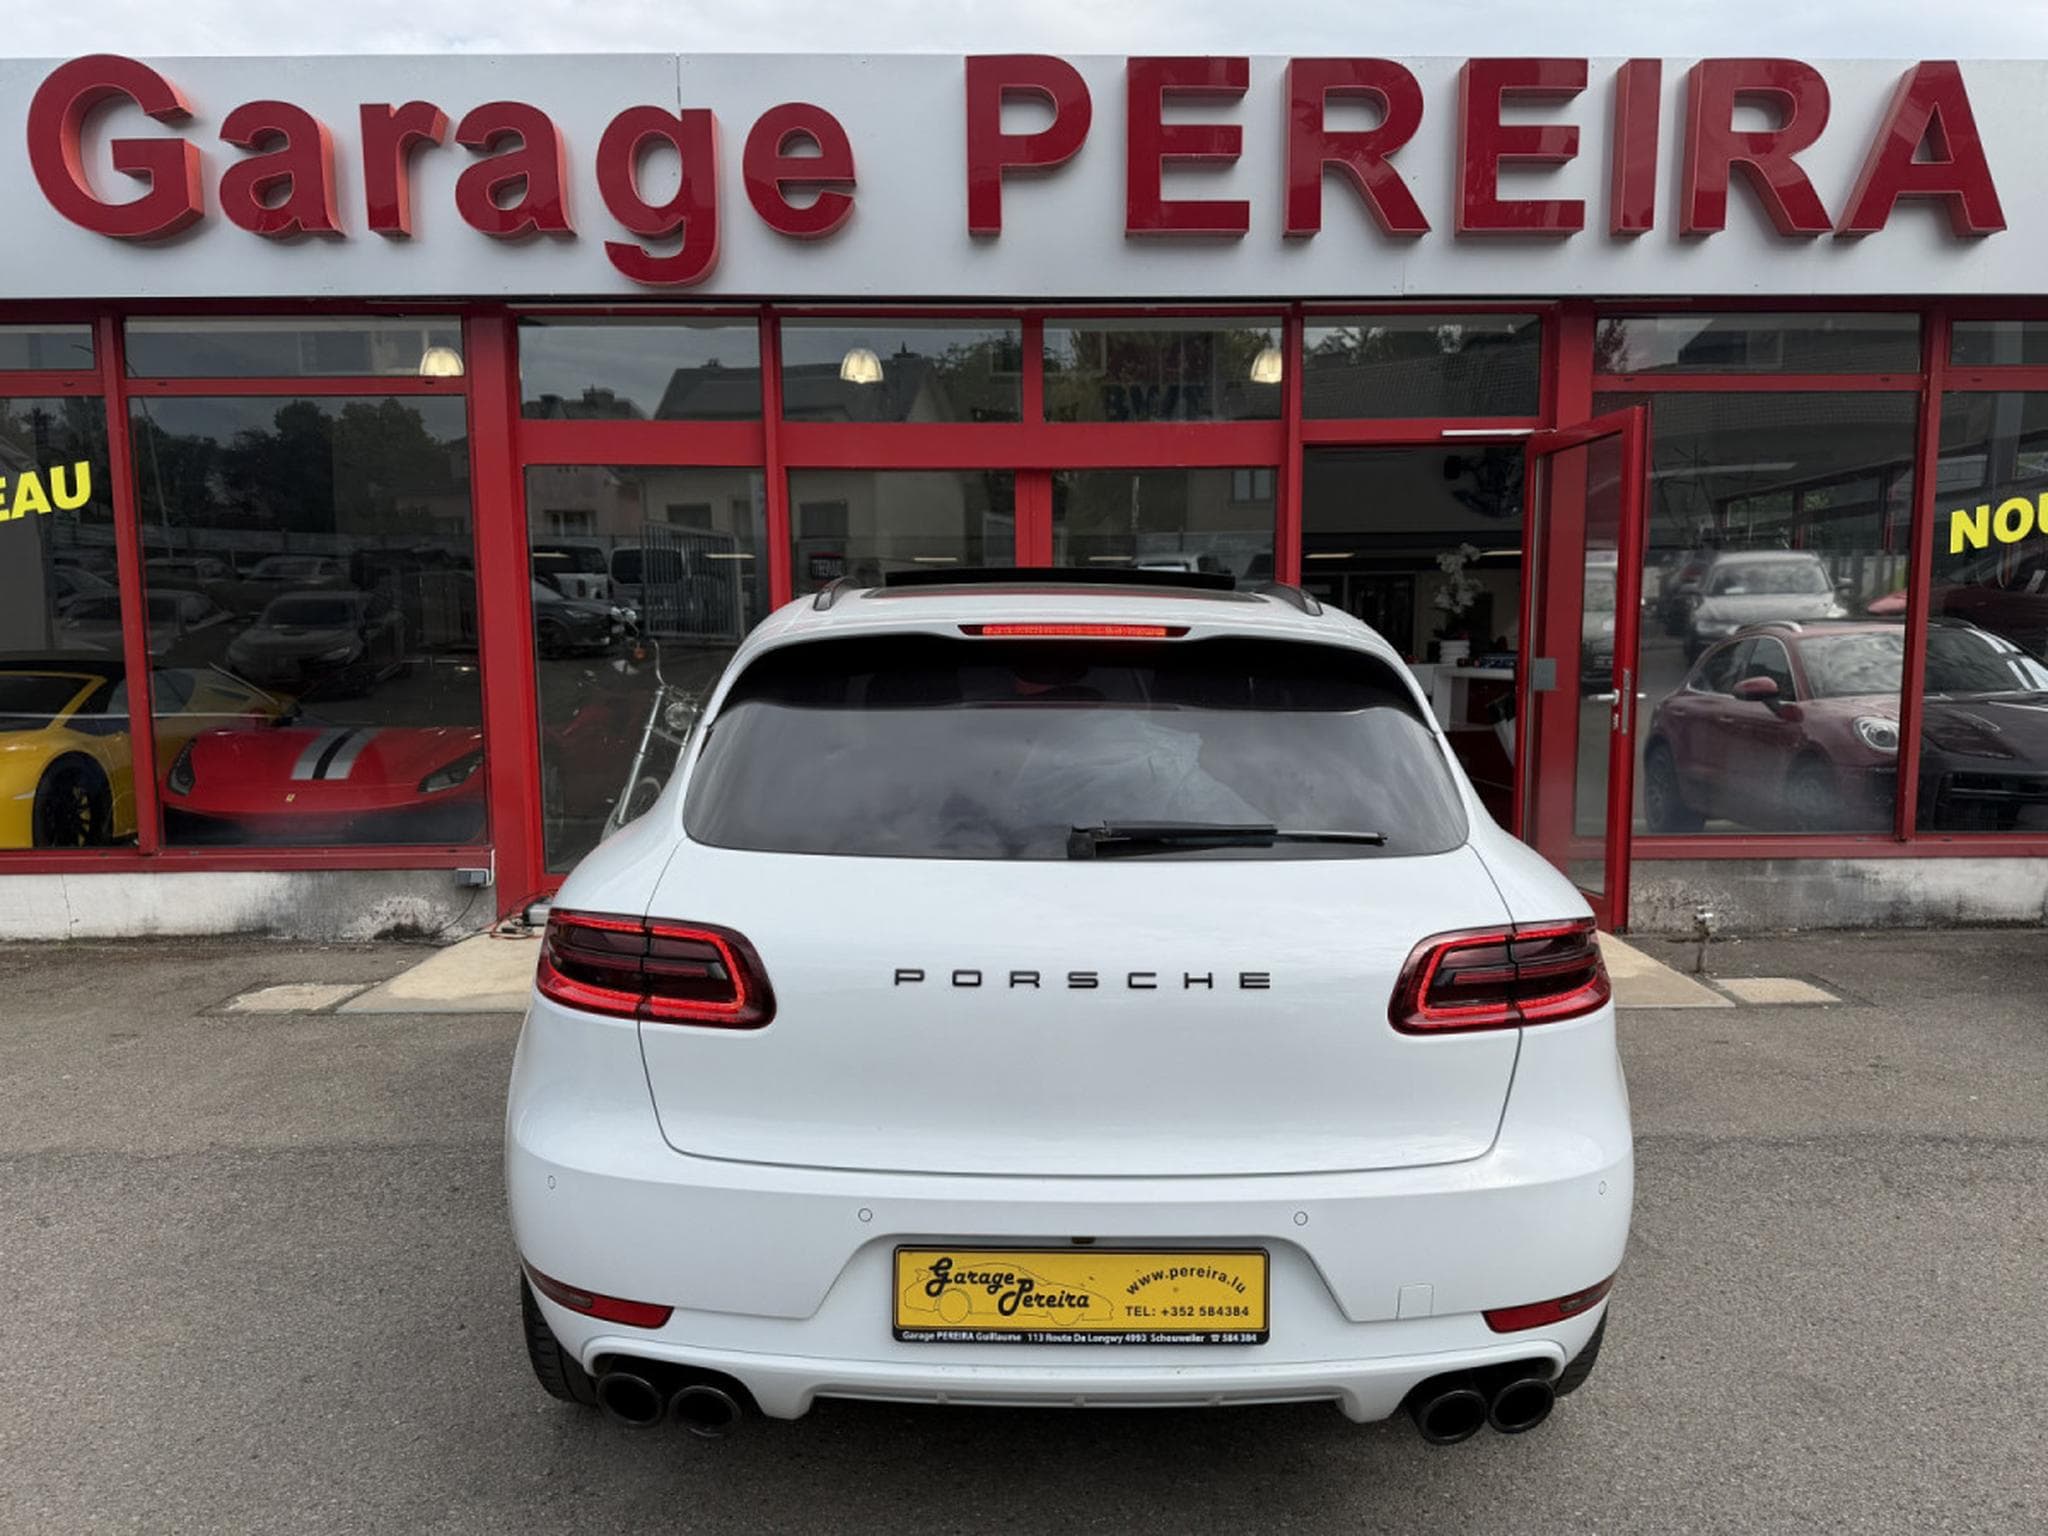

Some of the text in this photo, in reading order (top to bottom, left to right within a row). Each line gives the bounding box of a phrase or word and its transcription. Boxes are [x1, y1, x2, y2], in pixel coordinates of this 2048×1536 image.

[26, 52, 2007, 286] Garage PEREIRA
[1950, 492, 2048, 554] NO
[894, 968, 1270, 991] PORSCHE
[925, 1257, 1014, 1297] Garage
[1125, 1265, 1247, 1295] www.pereira.lu
[997, 1278, 1091, 1316] Pereira
[1125, 1305, 1250, 1317] TEL: +352 584384
[902, 1331, 935, 1342] Garage
[936, 1331, 974, 1341] PEREIRA
[976, 1332, 1022, 1341] Guillaume
[1028, 1332, 1043, 1342] 113
[1045, 1333, 1072, 1342] Route
[1073, 1333, 1086, 1342] De
[1087, 1333, 1124, 1344] Longwy
